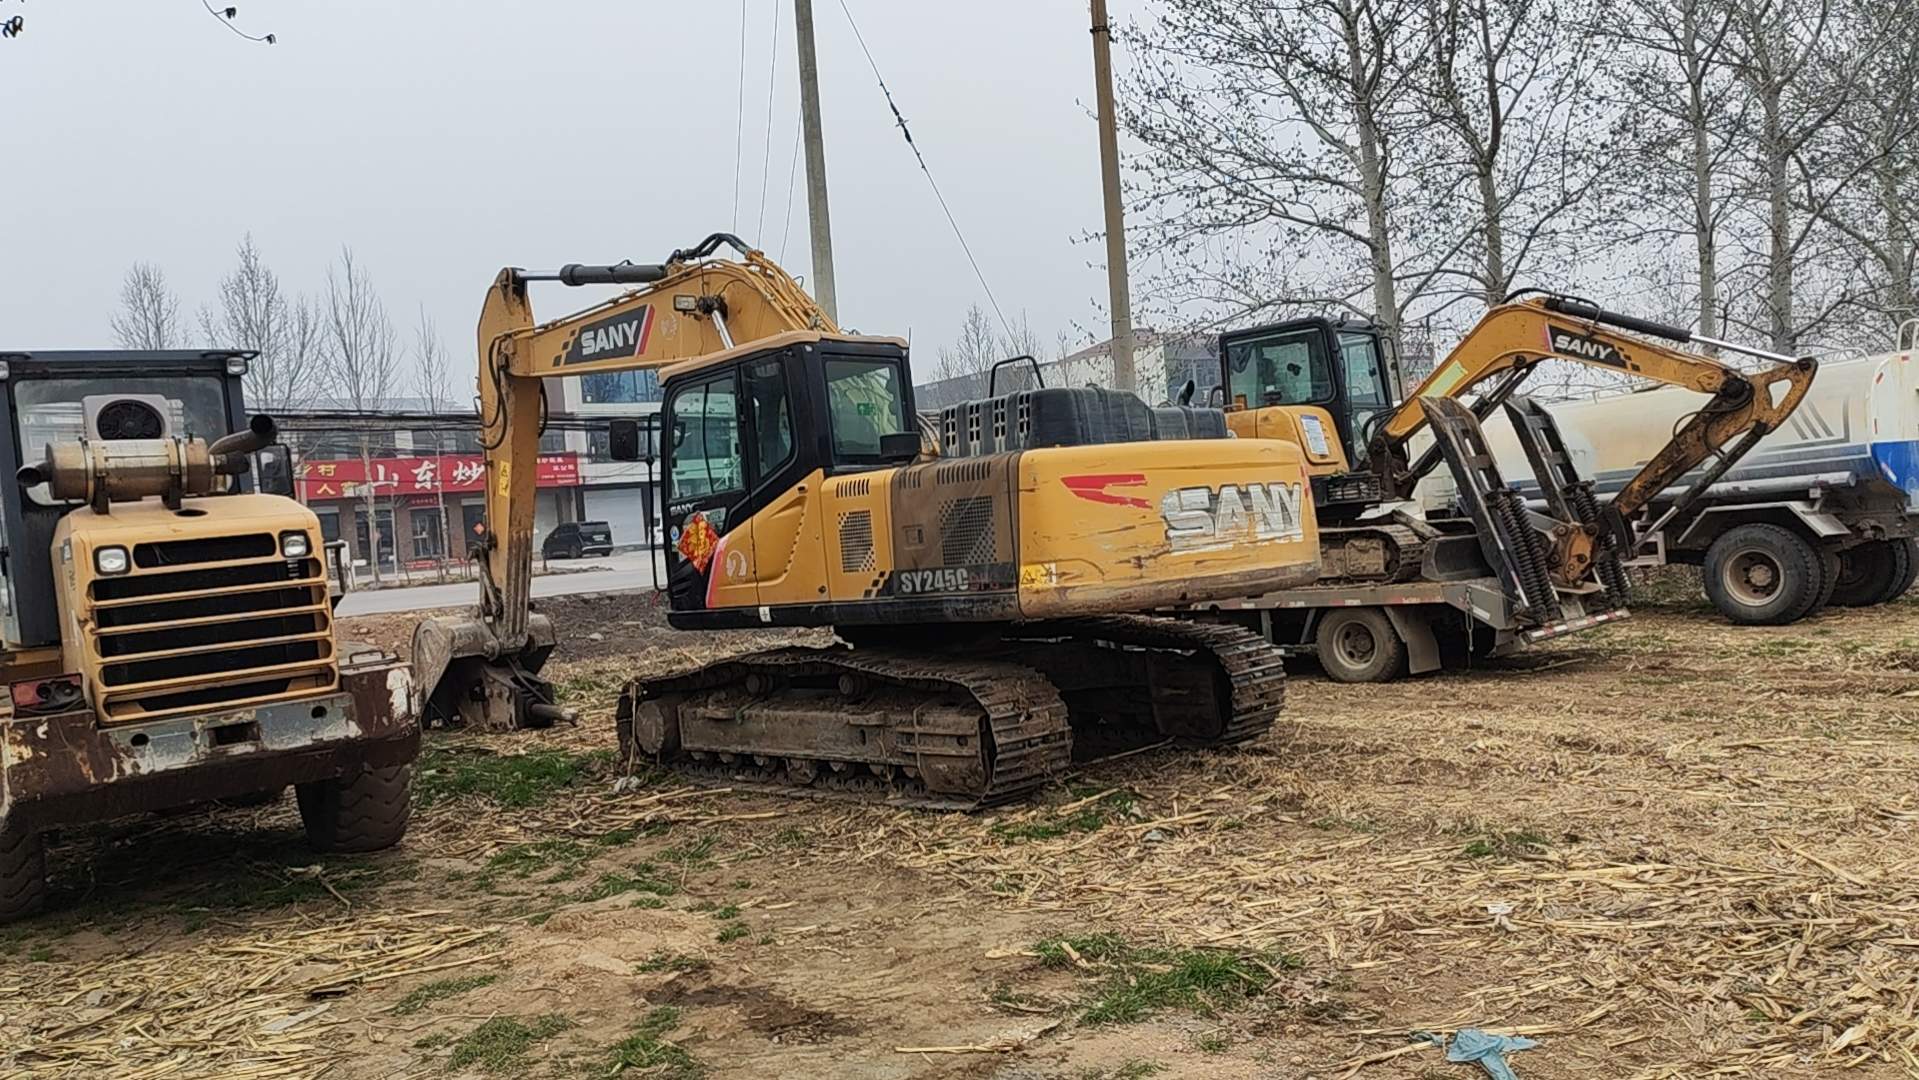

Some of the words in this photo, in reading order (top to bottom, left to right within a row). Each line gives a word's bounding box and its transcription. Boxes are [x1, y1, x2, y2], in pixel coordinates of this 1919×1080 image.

[581, 320, 639, 356] SANY
[1554, 334, 1613, 359] SANY
[670, 503, 694, 516] SANY
[1162, 482, 1303, 555] SANY
[901, 567, 969, 593] SY245C
